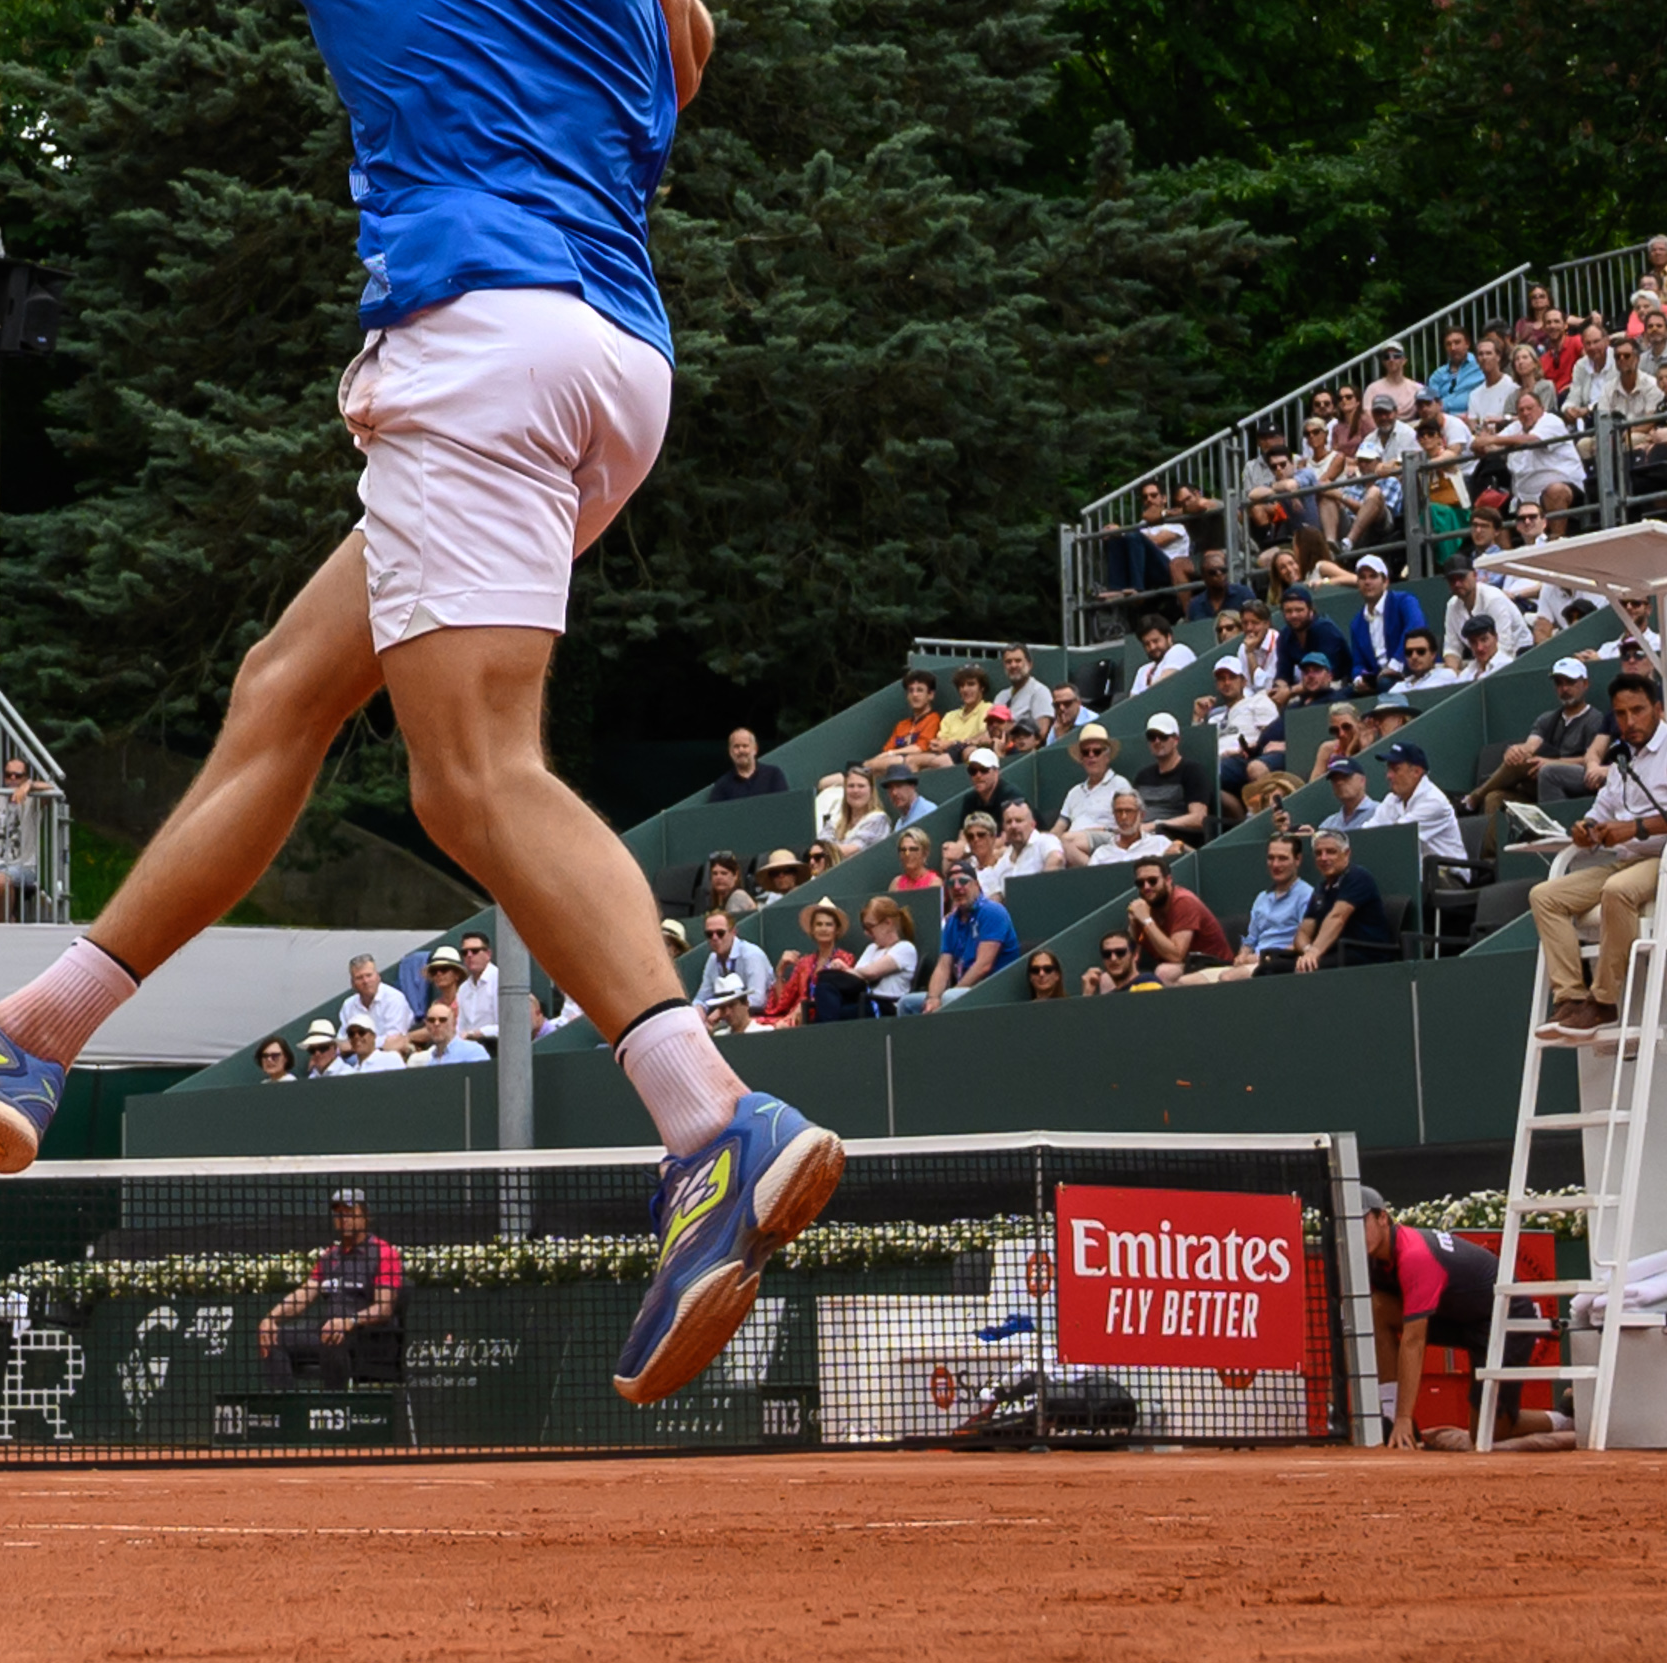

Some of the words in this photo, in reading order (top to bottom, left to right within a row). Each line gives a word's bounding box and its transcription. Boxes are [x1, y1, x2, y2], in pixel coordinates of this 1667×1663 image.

[1070, 1218, 1291, 1283] Emirates
[1106, 1288, 1154, 1335] FLY
[1161, 1290, 1259, 1338] BETTER
